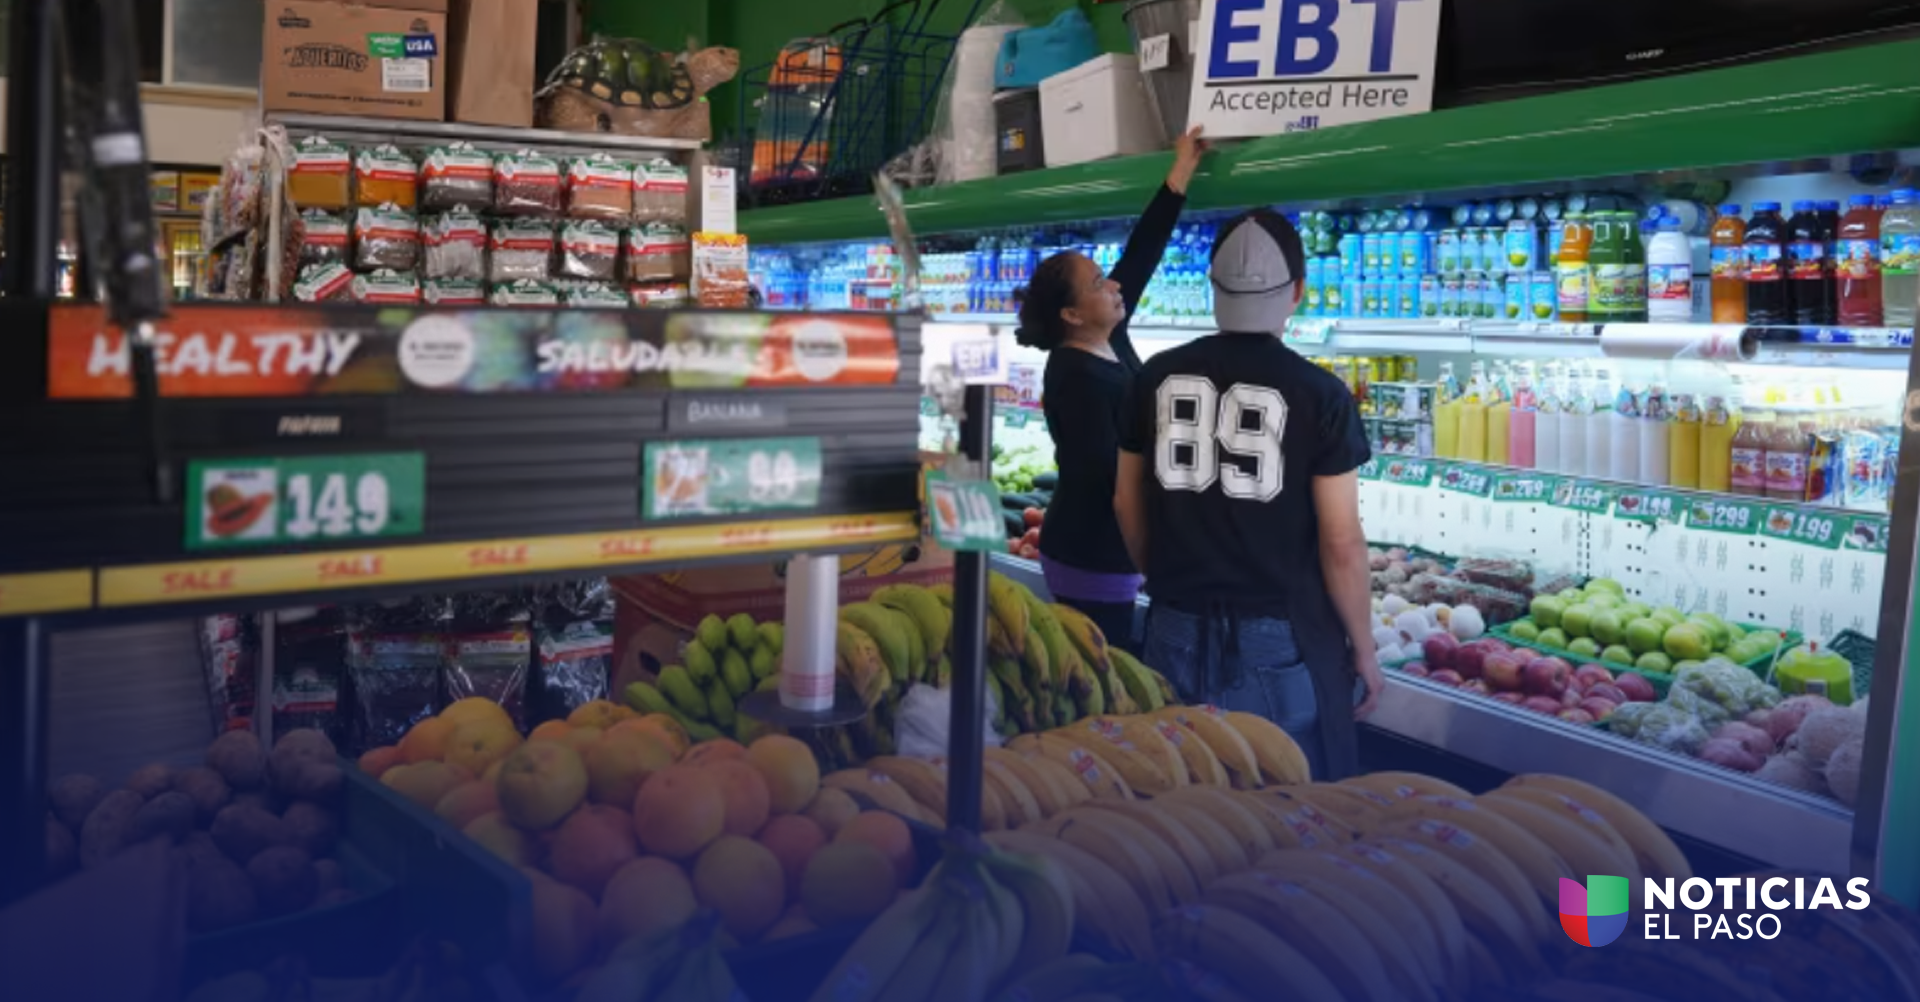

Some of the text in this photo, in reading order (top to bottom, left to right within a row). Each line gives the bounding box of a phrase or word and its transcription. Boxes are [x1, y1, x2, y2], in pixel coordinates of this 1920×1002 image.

[406, 39, 434, 53] USA
[1208, 0, 1424, 78] EBT
[1209, 84, 1409, 114] Accepted Here
[87, 332, 362, 376] HEALTHY
[1155, 374, 1288, 502] 89
[286, 466, 391, 538] 149
[1714, 505, 1750, 528] 299
[1794, 515, 1833, 542] 199
[162, 567, 236, 594] SALE
[318, 554, 385, 578] SALE
